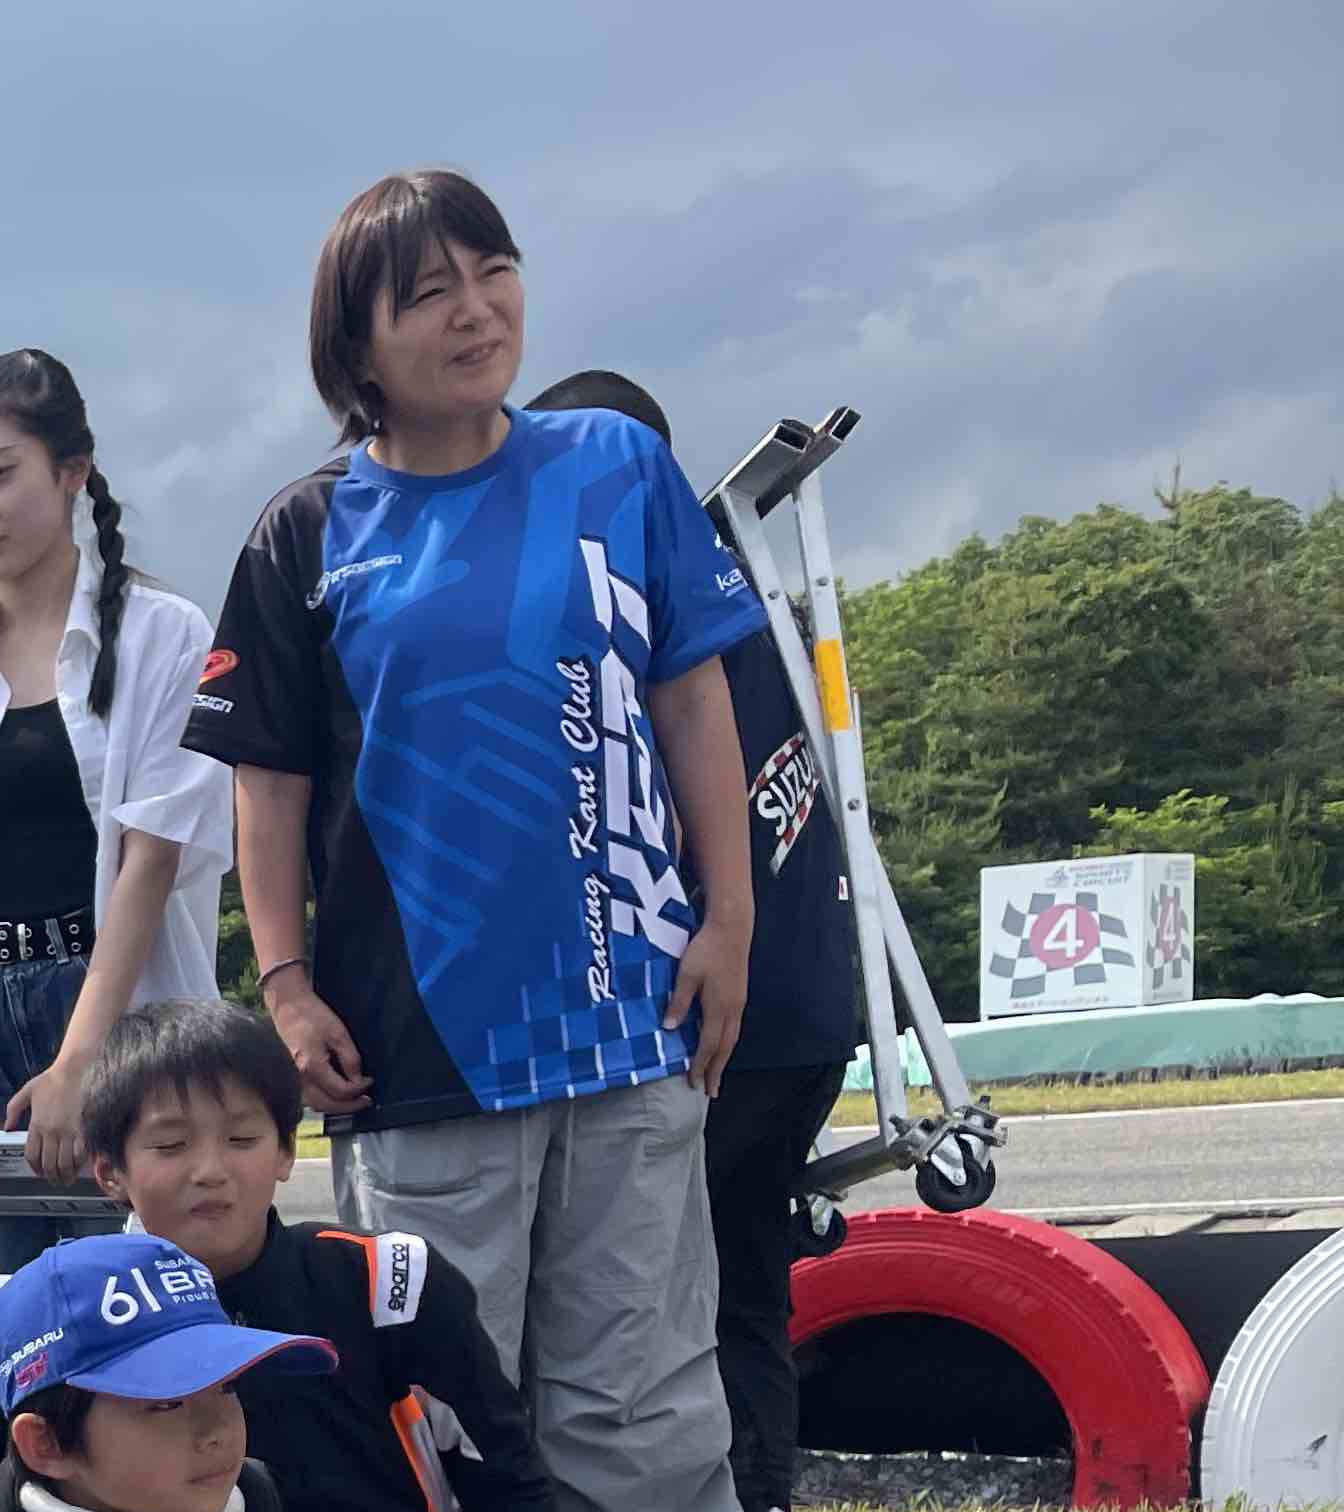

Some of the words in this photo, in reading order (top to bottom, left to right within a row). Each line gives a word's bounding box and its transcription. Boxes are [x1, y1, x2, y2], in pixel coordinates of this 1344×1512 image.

[560, 658, 593, 753] Club
[568, 762, 599, 860] Kart
[586, 872, 615, 1004] Racing
[1043, 908, 1085, 958] 4
[1163, 902, 1177, 950] 4
[100, 1266, 163, 1326] 61
[11, 1327, 64, 1365] SUBARU
